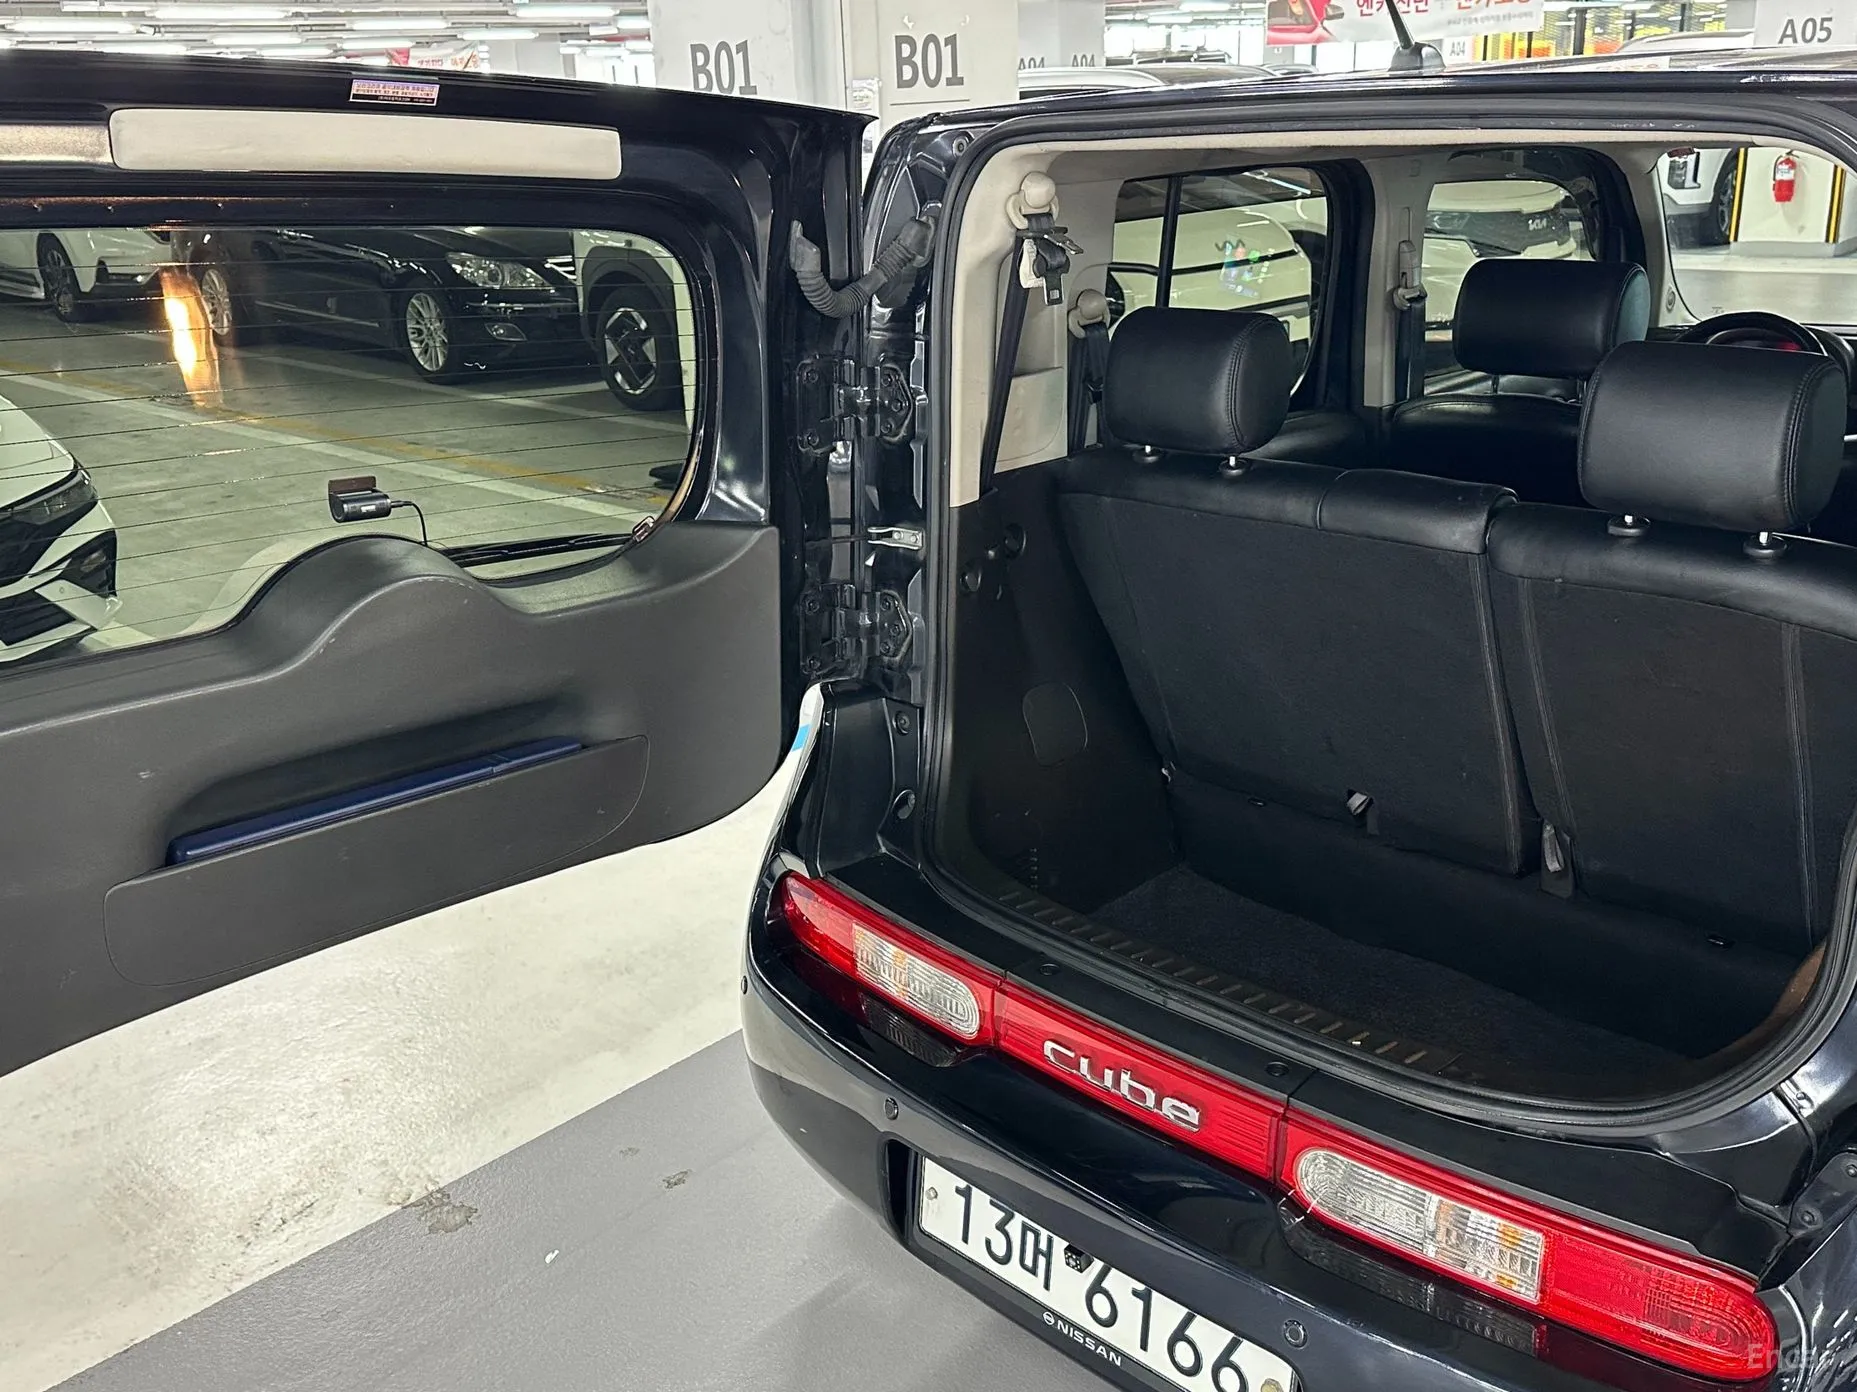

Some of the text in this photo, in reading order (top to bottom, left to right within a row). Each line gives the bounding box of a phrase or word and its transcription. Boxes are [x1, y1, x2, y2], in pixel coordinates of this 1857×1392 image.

[1778, 17, 1833, 45] A05
[690, 40, 757, 95] B01
[894, 33, 964, 89] B01
[954, 1183, 1249, 1392] 13머 6166
[1057, 1313, 1122, 1367] NISSAN
